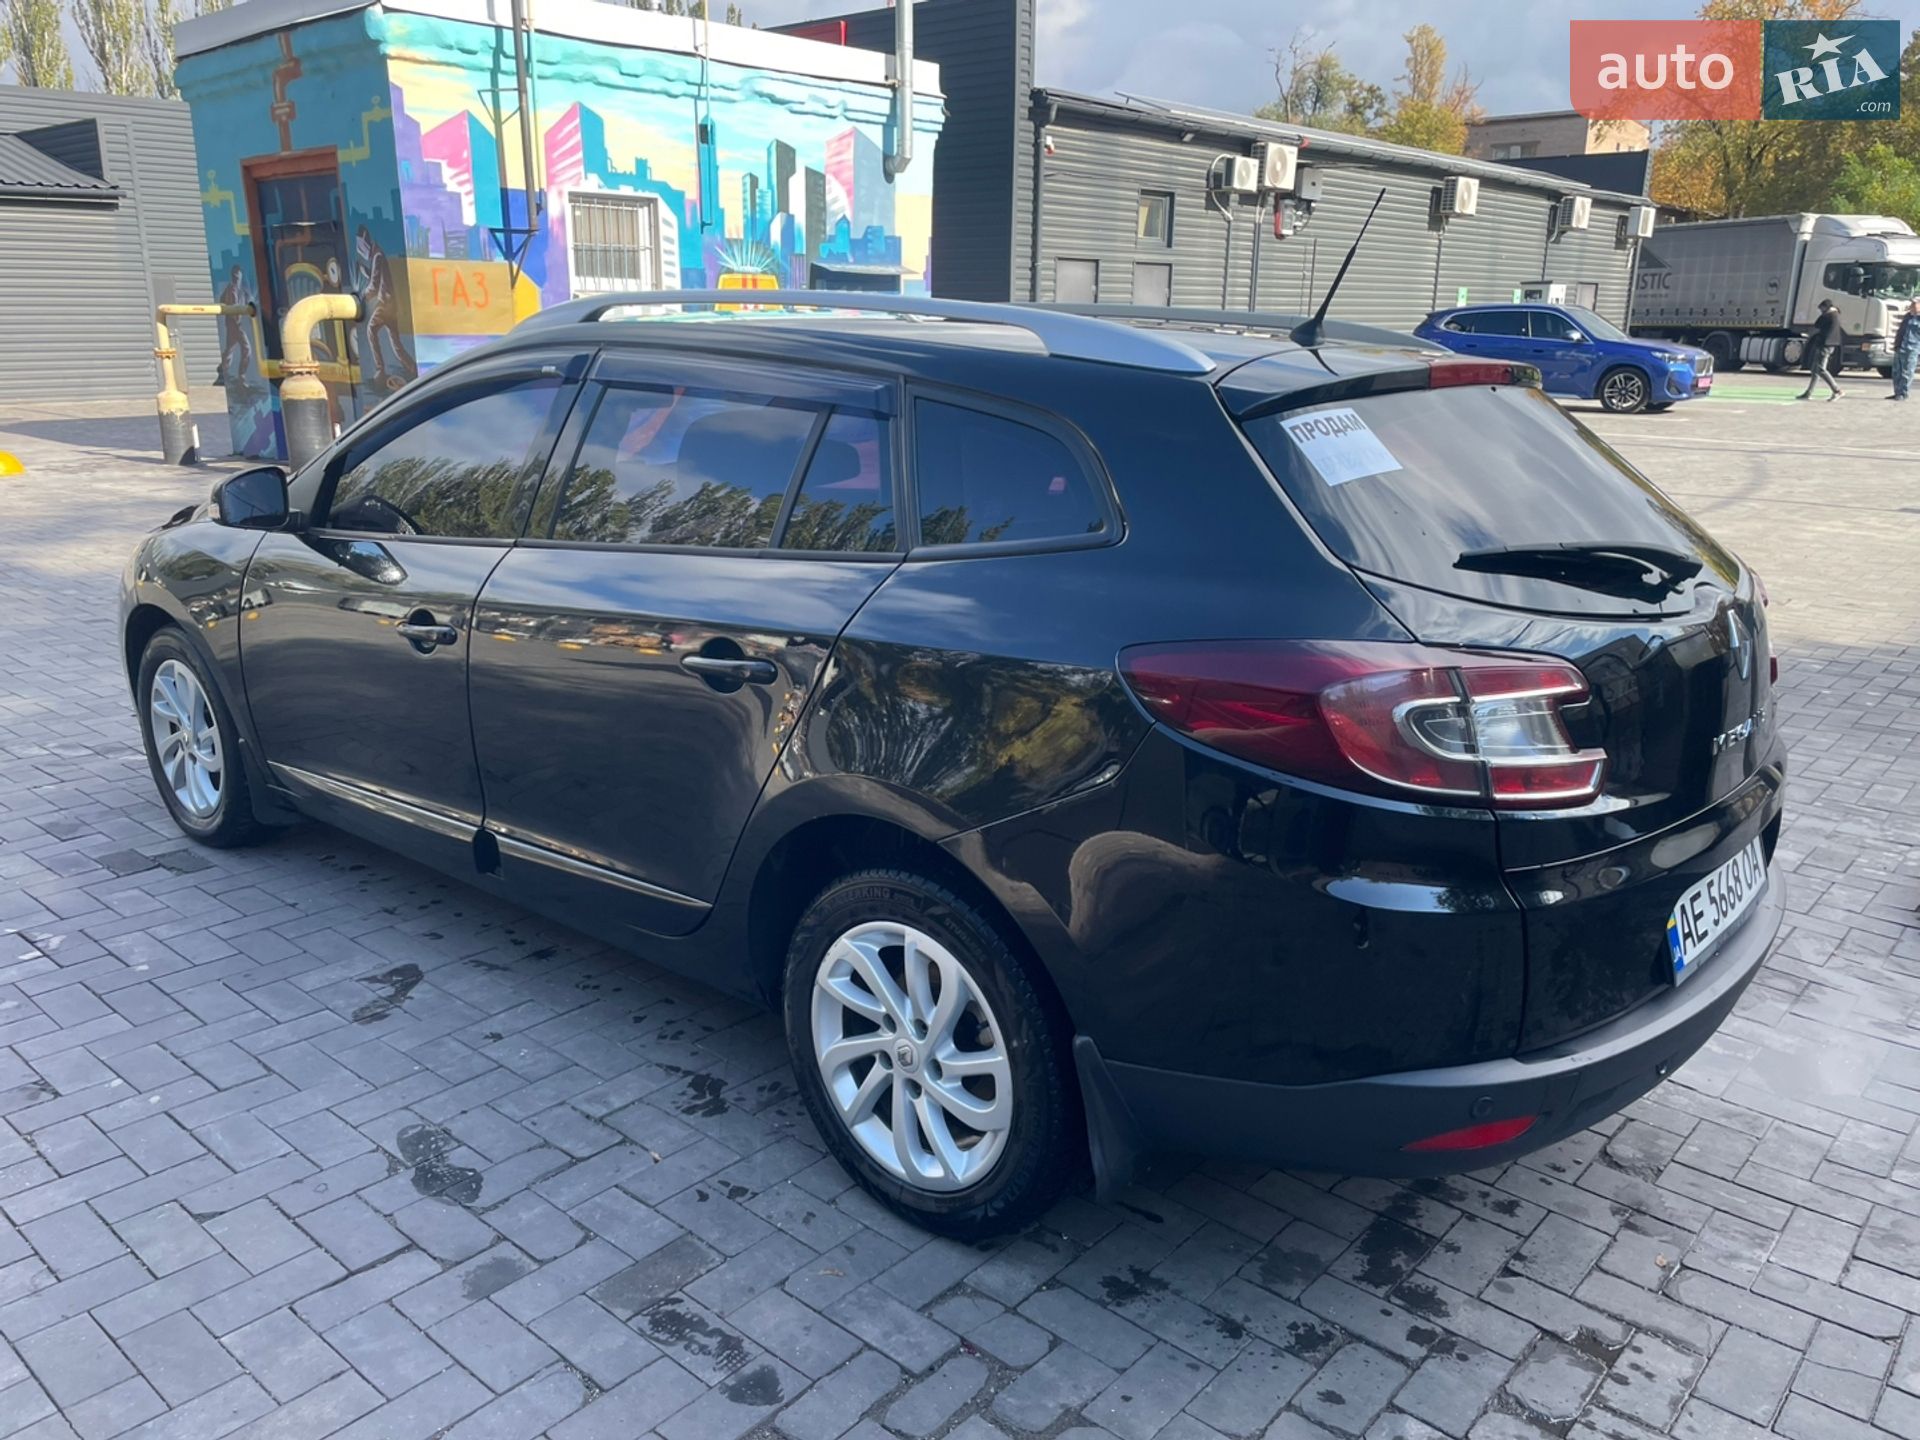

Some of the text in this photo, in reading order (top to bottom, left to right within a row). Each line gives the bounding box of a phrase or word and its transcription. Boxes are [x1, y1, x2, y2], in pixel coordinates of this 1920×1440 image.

[431, 265, 490, 310] ГАЗ
[1288, 413, 1366, 443] ПРОДАМ
[1712, 707, 1766, 756] MEGA
[1680, 840, 1762, 956] AE 5668 OA
